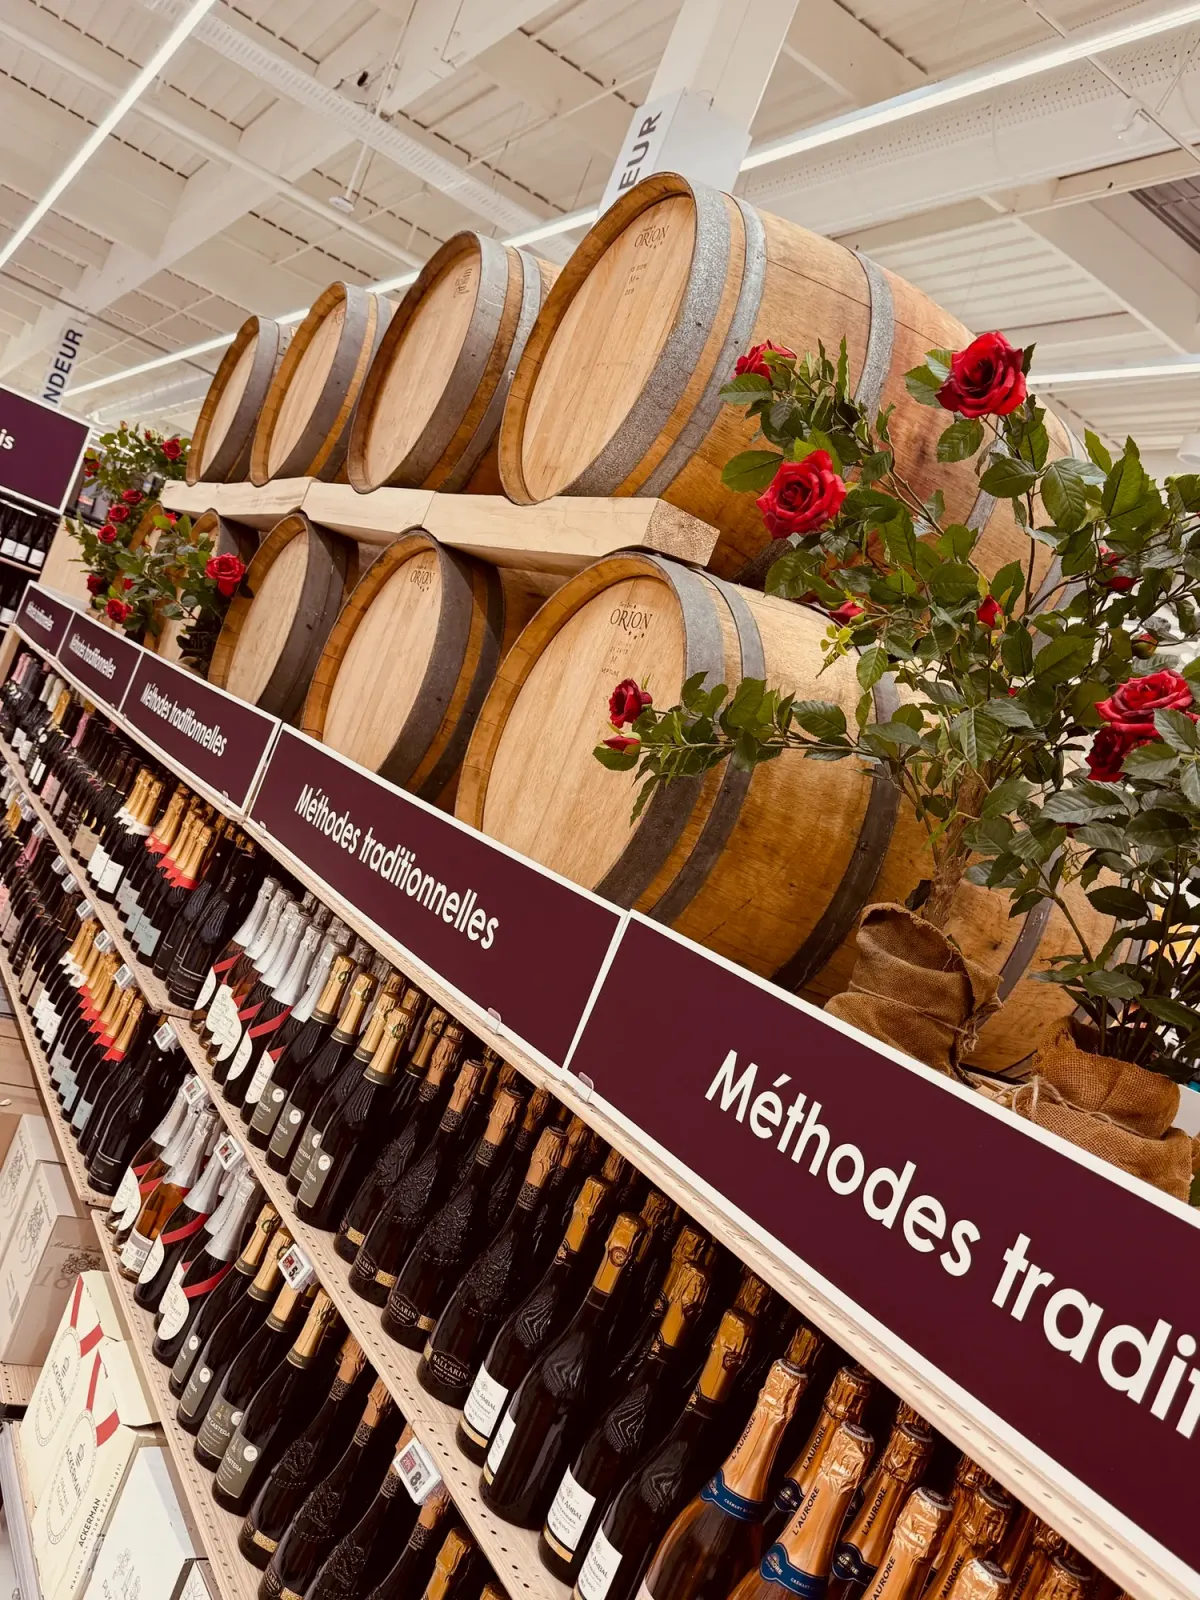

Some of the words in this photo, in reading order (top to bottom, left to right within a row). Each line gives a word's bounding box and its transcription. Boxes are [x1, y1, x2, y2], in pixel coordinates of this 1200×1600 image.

[618, 110, 662, 190] EUR
[634, 225, 670, 248] ORION
[43, 329, 83, 404] NDEUR
[610, 608, 652, 631] ORION
[168, 701, 227, 757] traditionnelles
[294, 784, 361, 854] Méthodes
[358, 827, 499, 950] traditionnelles
[705, 1049, 980, 1277] Méthodes
[288, 1266, 298, 1277] 5
[433, 1354, 469, 1380] BALLARIN
[731, 1415, 756, 1460] L'AURORE
[802, 1424, 827, 1471] L'AURORE
[410, 1471, 421, 1486] 8
[78, 1497, 101, 1548] ACKERMAN
[564, 1500, 583, 1521] AMBAL
[792, 1485, 820, 1537] L'AURORE
[861, 1487, 888, 1537] L'AURORE
